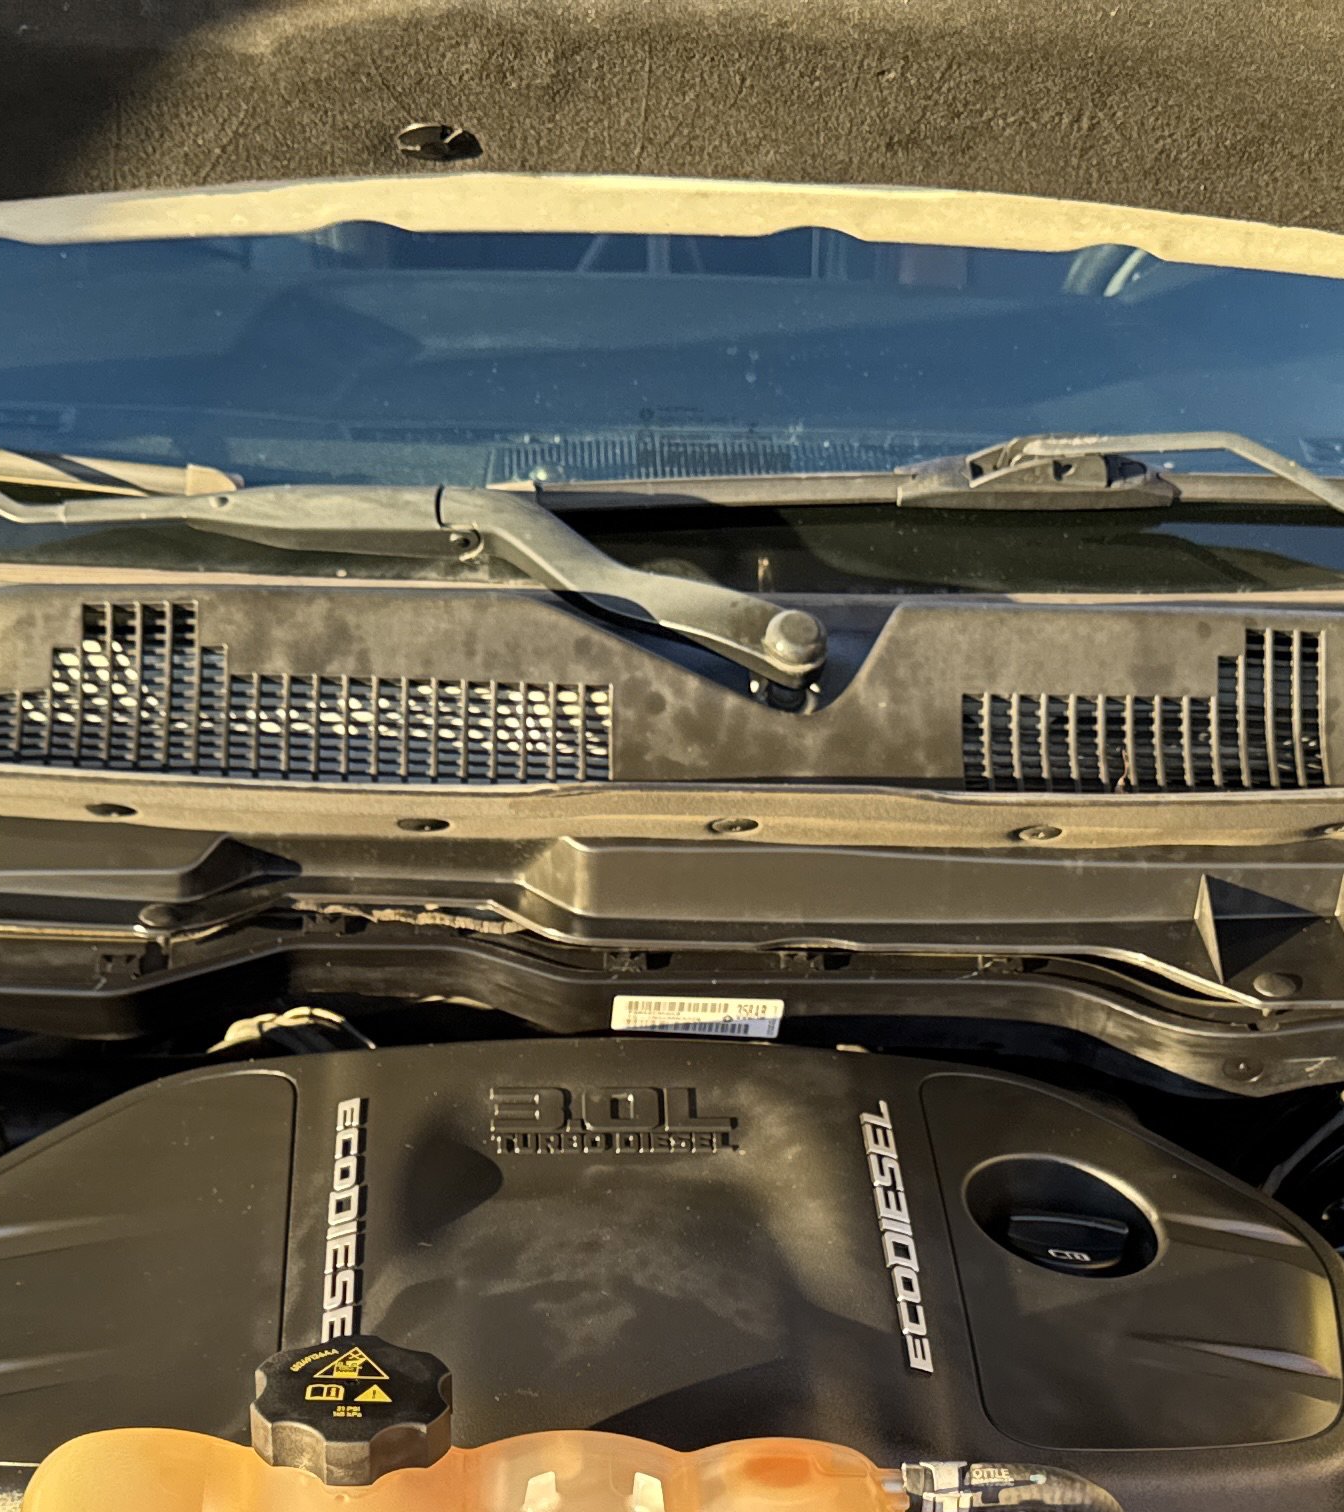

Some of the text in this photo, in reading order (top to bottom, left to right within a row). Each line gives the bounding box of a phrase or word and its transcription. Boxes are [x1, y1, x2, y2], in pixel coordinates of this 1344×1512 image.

[490, 1087, 739, 1134] 3.0L
[492, 1133, 740, 1154] TURBO DIESEL
[321, 1097, 362, 1344] ECODIESE
[859, 1100, 934, 1374] ECODIESEL
